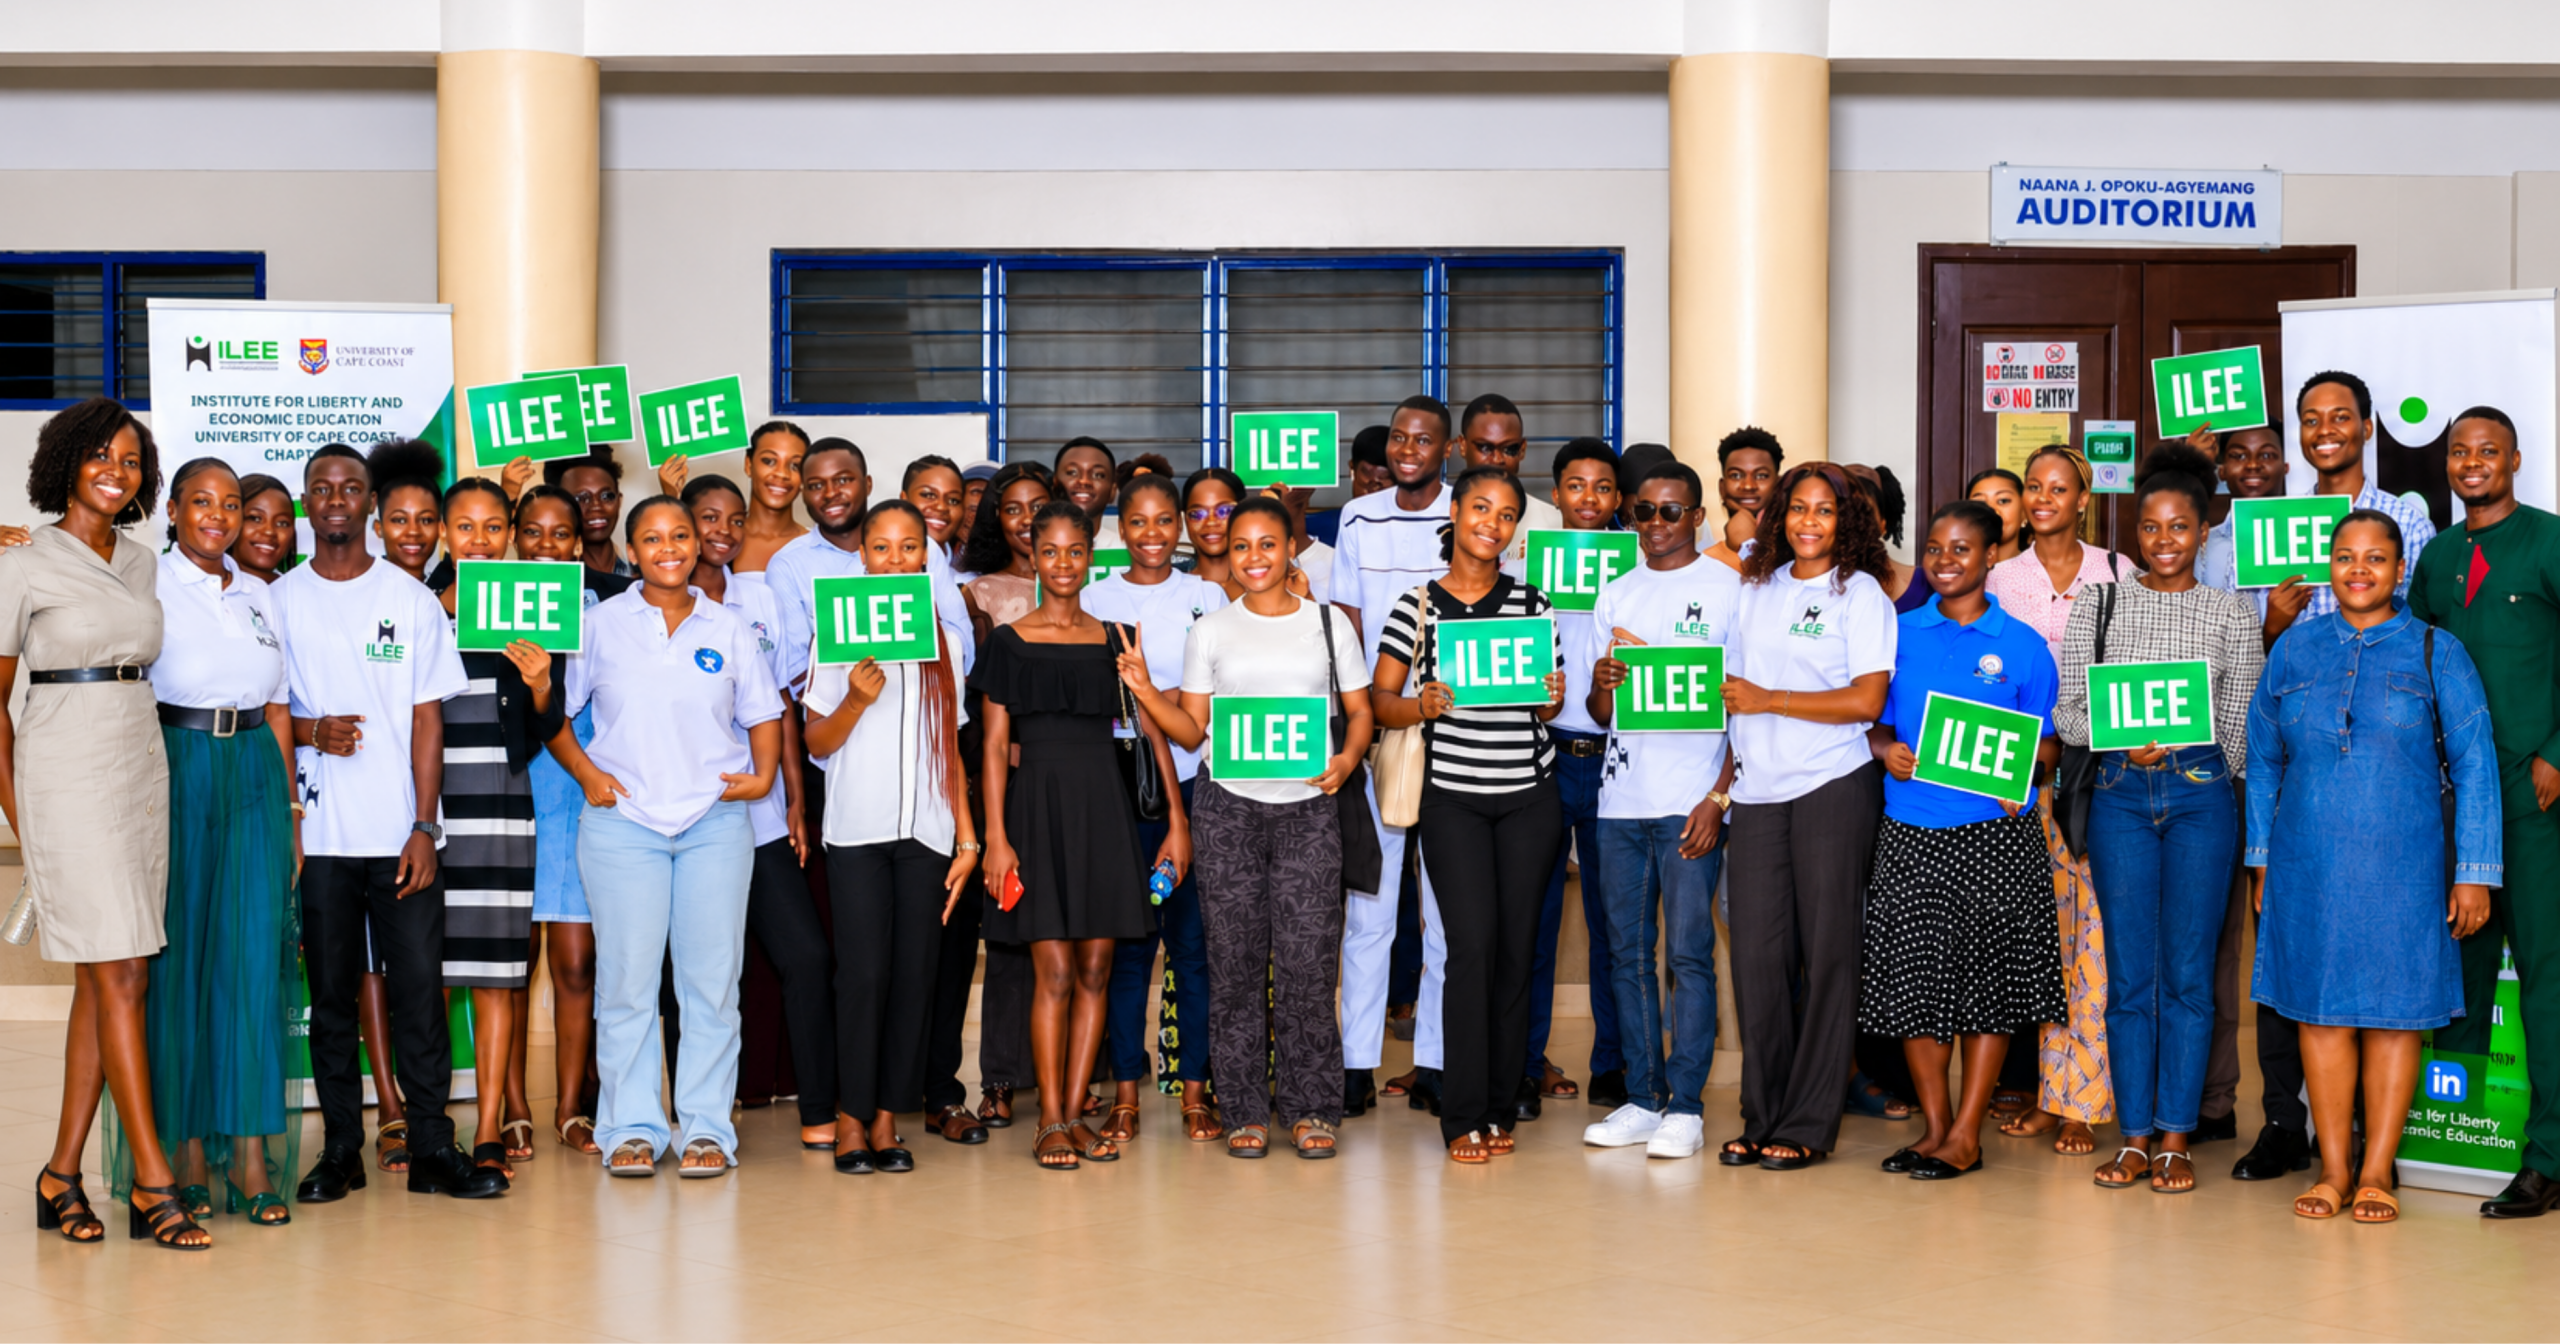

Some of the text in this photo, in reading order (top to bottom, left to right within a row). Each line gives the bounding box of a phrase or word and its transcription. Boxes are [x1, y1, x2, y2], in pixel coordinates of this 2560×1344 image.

[2019, 178, 2256, 195] NAANA J. OPOKU-AGYEMANG
[2016, 197, 2257, 228] AUDITORIUM
[218, 340, 279, 360] ILEE
[335, 346, 415, 356] UNIVERSITY OF
[335, 357, 404, 367] CAPE COAST
[190, 395, 404, 409] INSTITUTE FOR LIBERTY AND
[581, 382, 616, 428] EE
[2012, 387, 2075, 409] NO ENTRY
[2171, 365, 2247, 418] ILEE
[209, 413, 382, 426] ECONOMIC EDUCATION
[486, 394, 568, 448] ILEE
[656, 394, 730, 447] ILEE
[194, 431, 397, 444] UNIVERSITY OF CAPE COAST
[1249, 428, 1320, 471] ILEE
[264, 448, 315, 461] CHAPT
[2253, 515, 2333, 567] ILEE
[476, 581, 562, 631] ILEE
[833, 593, 916, 644] ILEE
[366, 642, 405, 660] ILEE
[1455, 636, 1537, 687] ILEE
[1632, 664, 1709, 713] ILEE
[2108, 679, 2192, 730] ILEE
[1230, 713, 1309, 761] ILEE
[1936, 717, 2021, 781] ILEE
[2432, 1066, 2461, 1097] in
[2450, 1112, 2500, 1134] Liberty
[2446, 1128, 2516, 1150] Education
